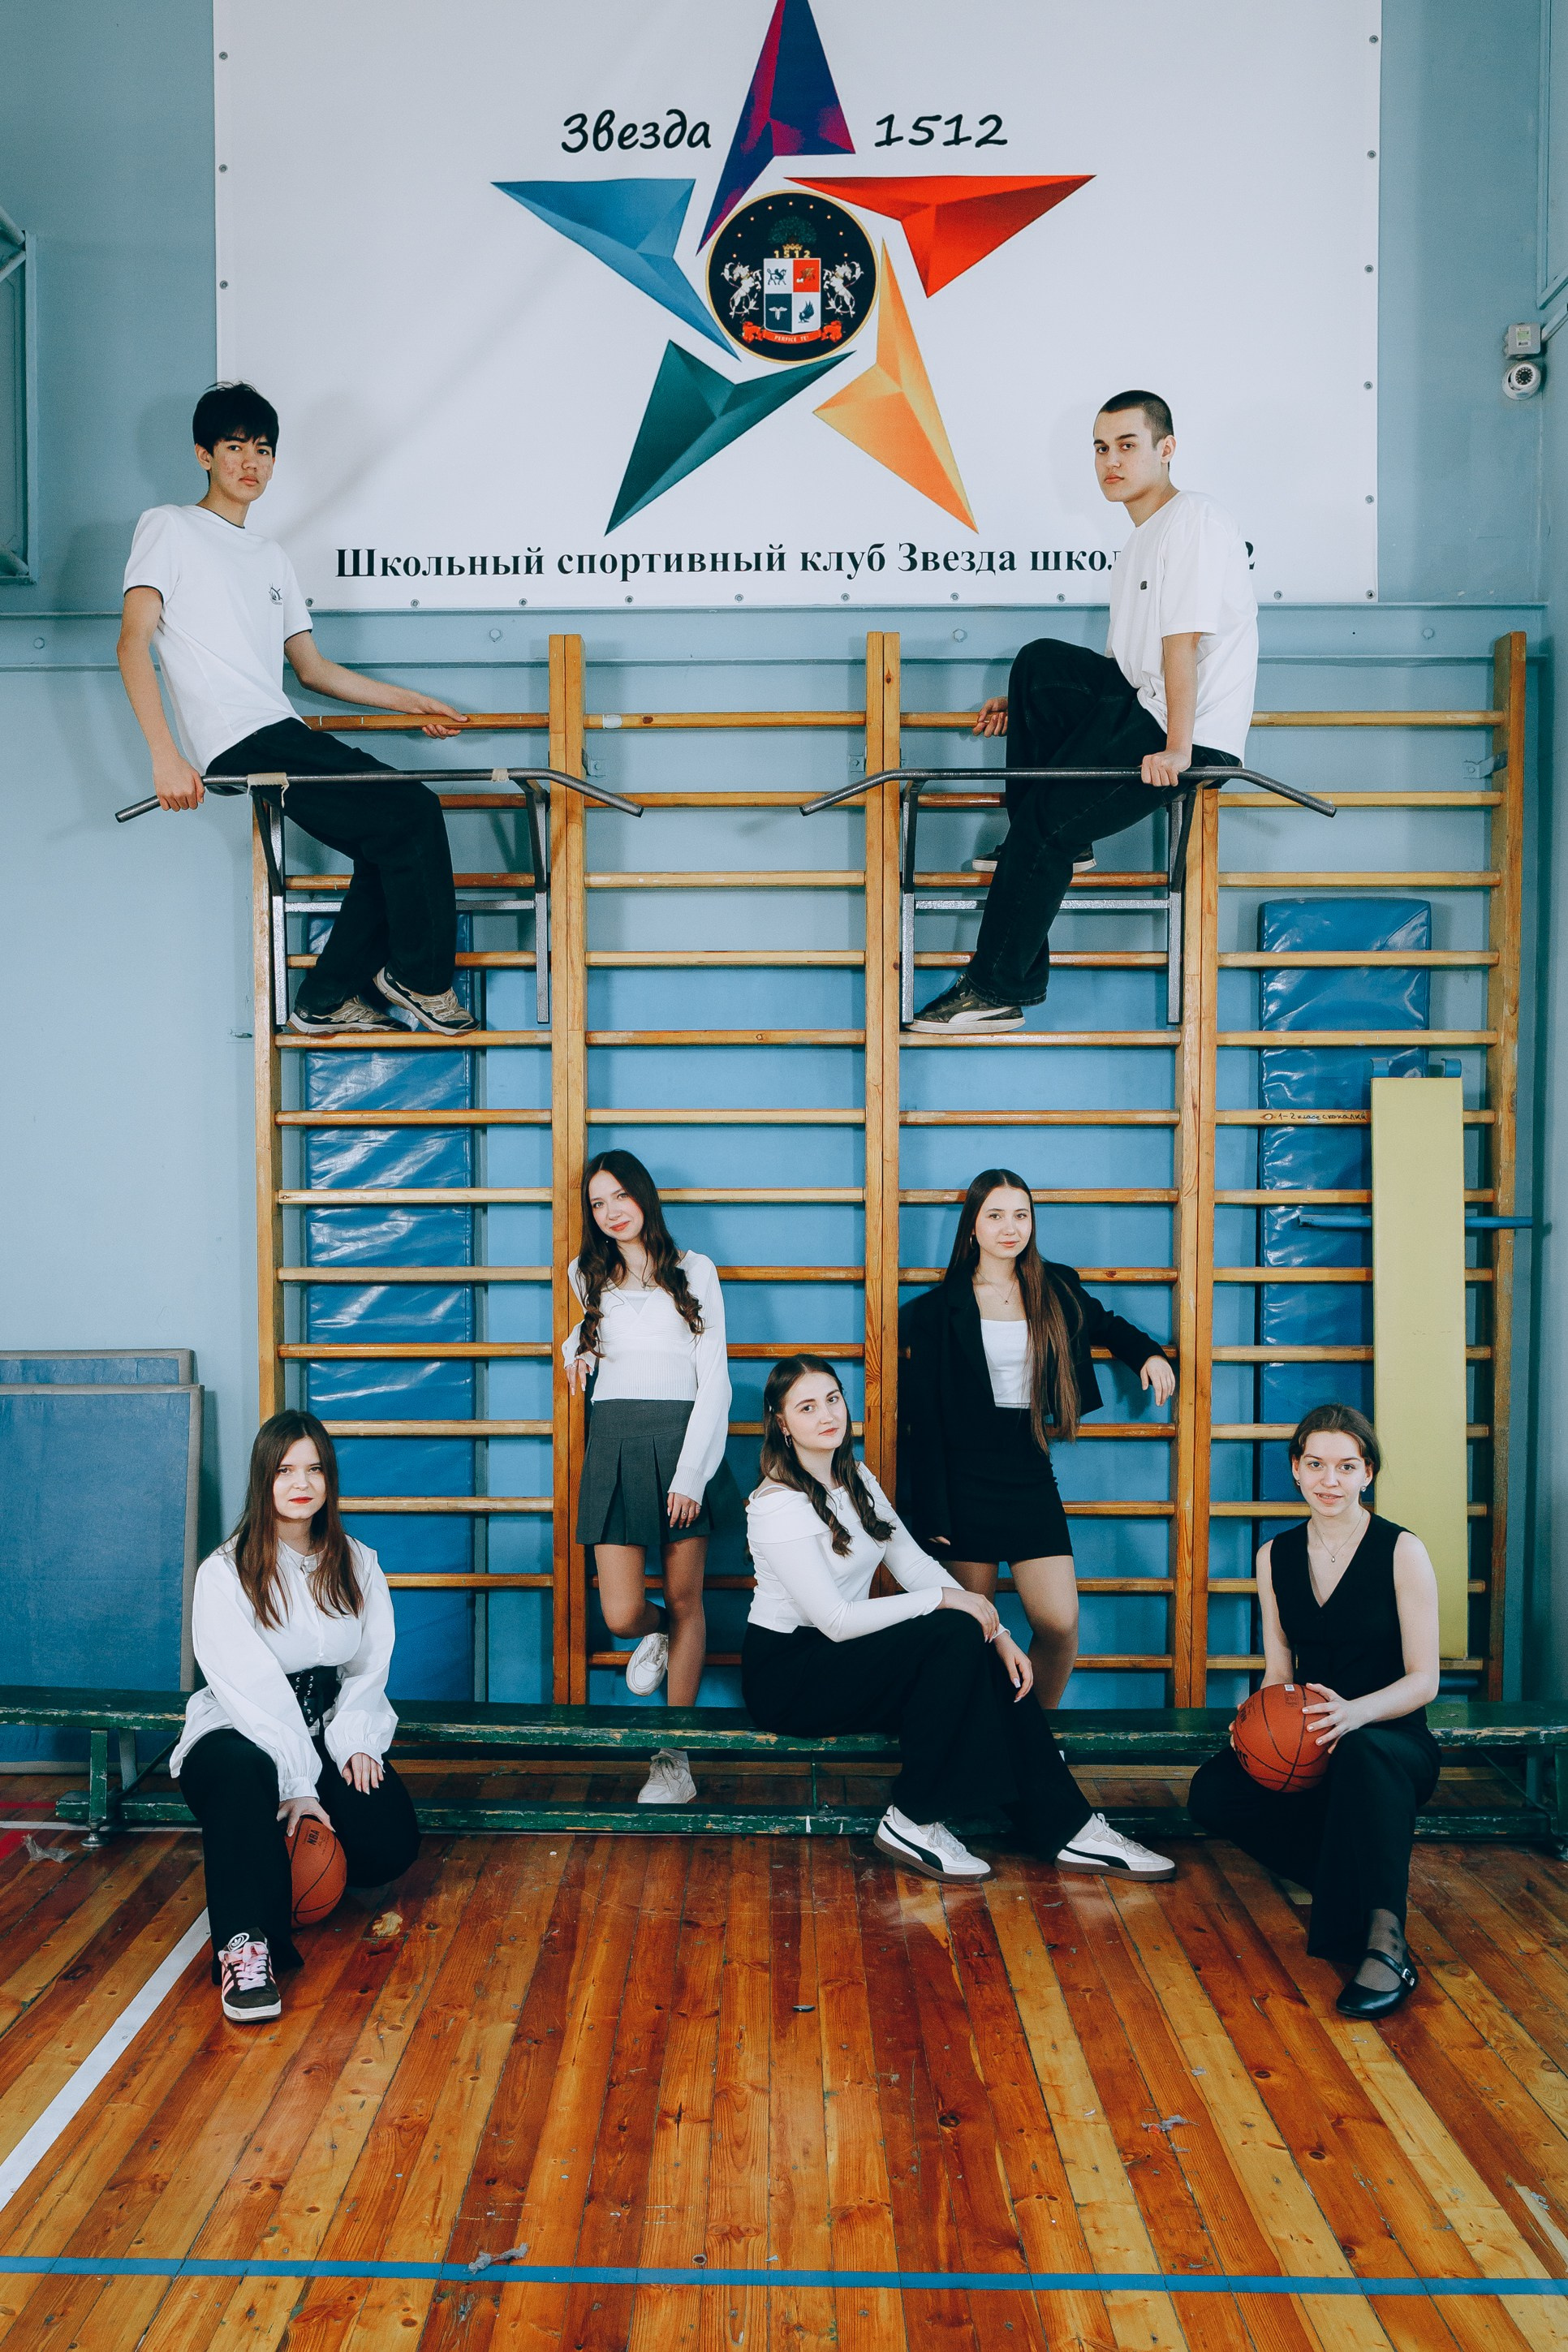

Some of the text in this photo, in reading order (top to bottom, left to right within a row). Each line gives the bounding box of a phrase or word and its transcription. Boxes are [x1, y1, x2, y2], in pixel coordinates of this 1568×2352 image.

[561, 108, 1008, 153] Звезда 1512
[773, 250, 811, 259] 1512
[335, 546, 544, 577] Школьный
[557, 544, 786, 582] спортивный
[799, 543, 885, 580] клуб
[898, 542, 1017, 575] Звезда
[307, 1829, 320, 1846] NBA
